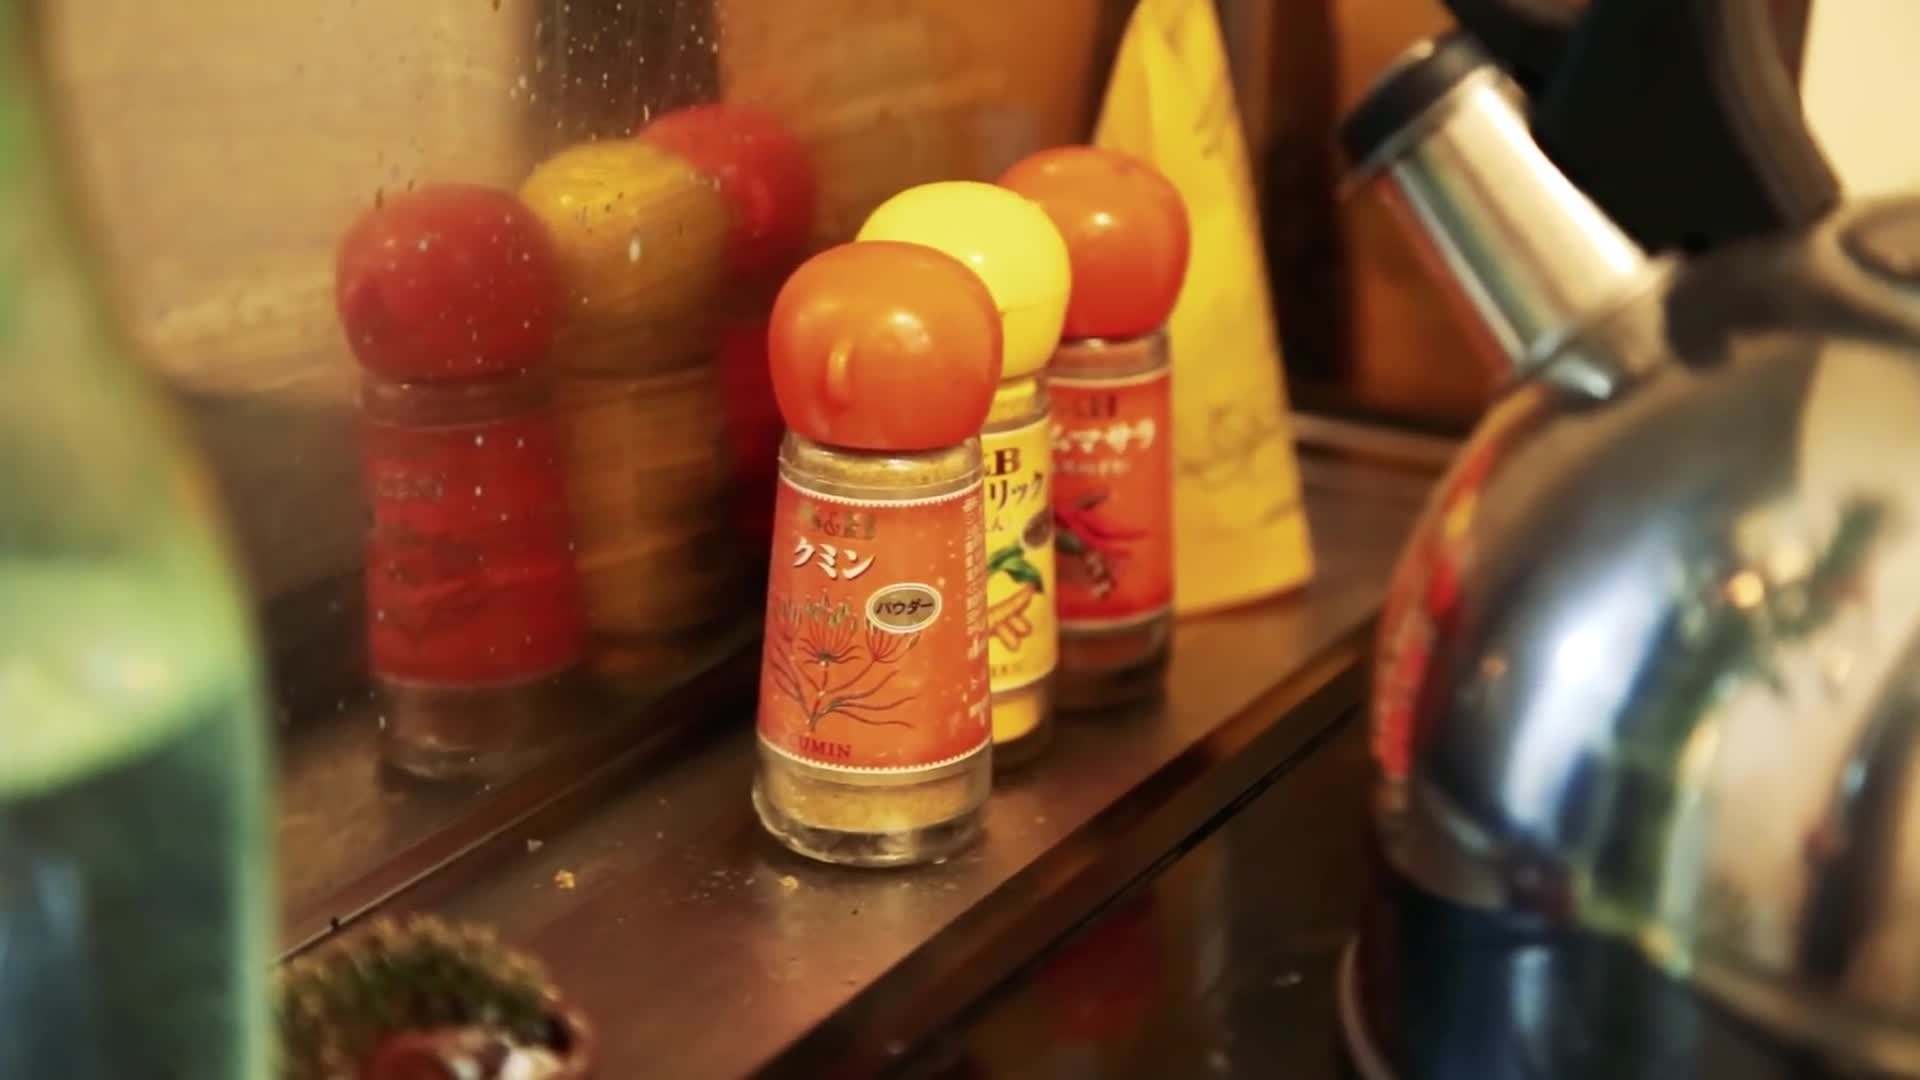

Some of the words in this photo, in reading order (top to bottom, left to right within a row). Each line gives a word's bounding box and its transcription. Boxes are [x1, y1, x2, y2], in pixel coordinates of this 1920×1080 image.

[793, 535, 876, 580] クミン
[875, 597, 934, 615] パウダー
[796, 735, 852, 758] UMIN
